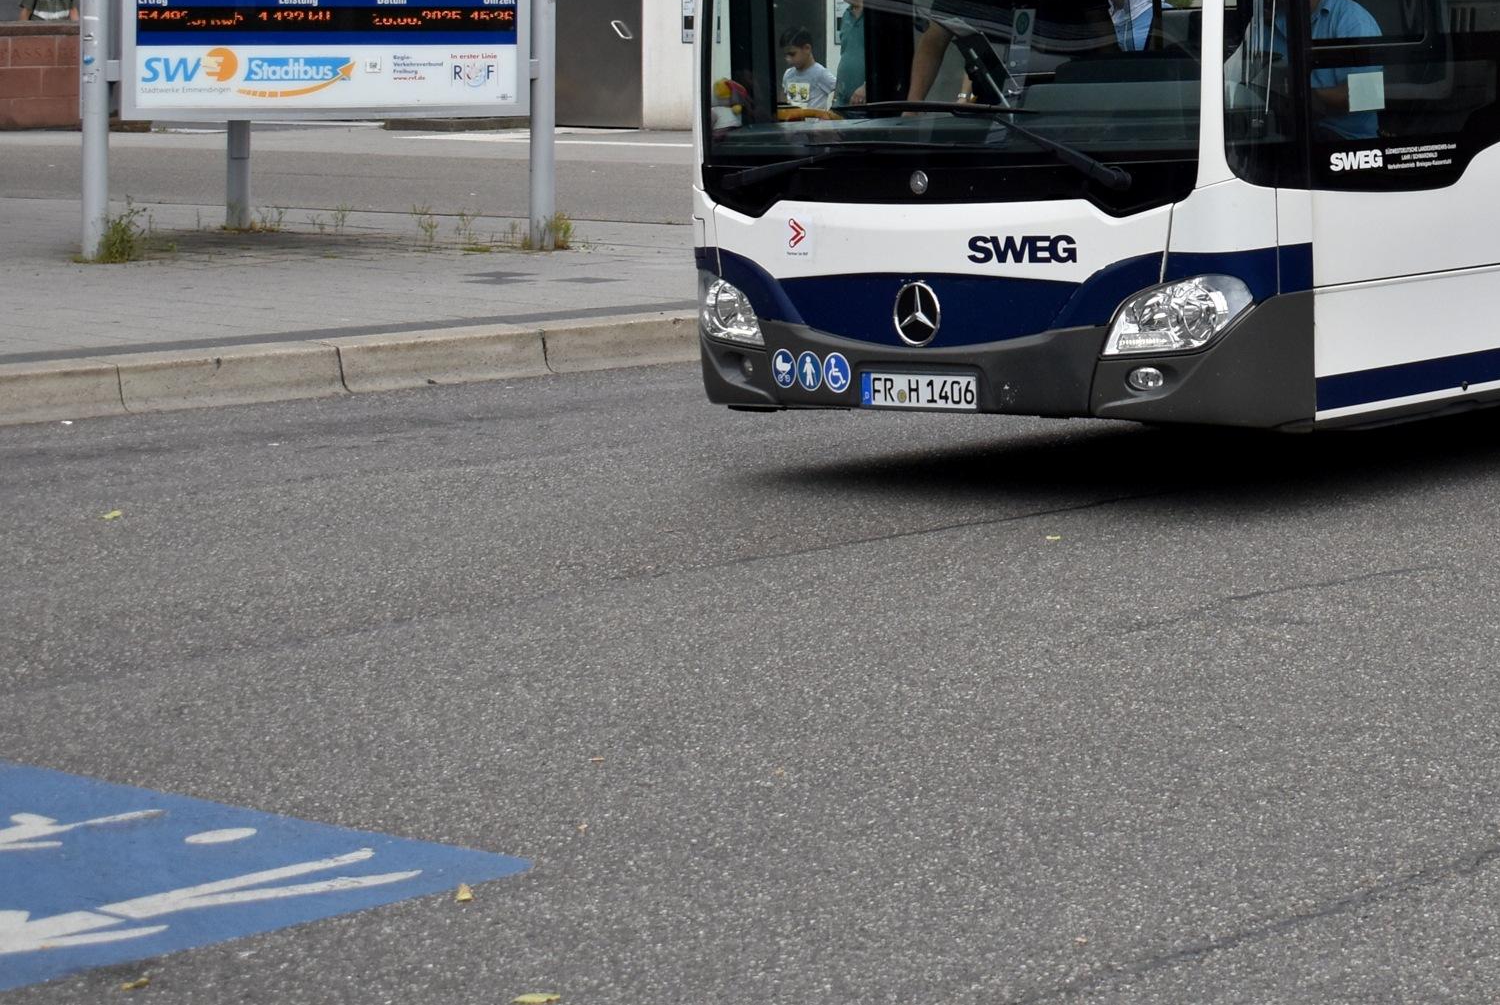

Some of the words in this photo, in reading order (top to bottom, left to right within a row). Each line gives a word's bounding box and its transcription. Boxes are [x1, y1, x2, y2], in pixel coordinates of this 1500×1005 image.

[250, 58, 334, 81] Stadtbus
[140, 86, 179, 94] Stadtwerke
[181, 86, 232, 95] Emmendingen
[1330, 148, 1383, 172] SWEG
[967, 234, 1078, 264] SWEG
[872, 377, 895, 402] FR
[908, 379, 920, 403] H
[926, 379, 975, 405] 1406
